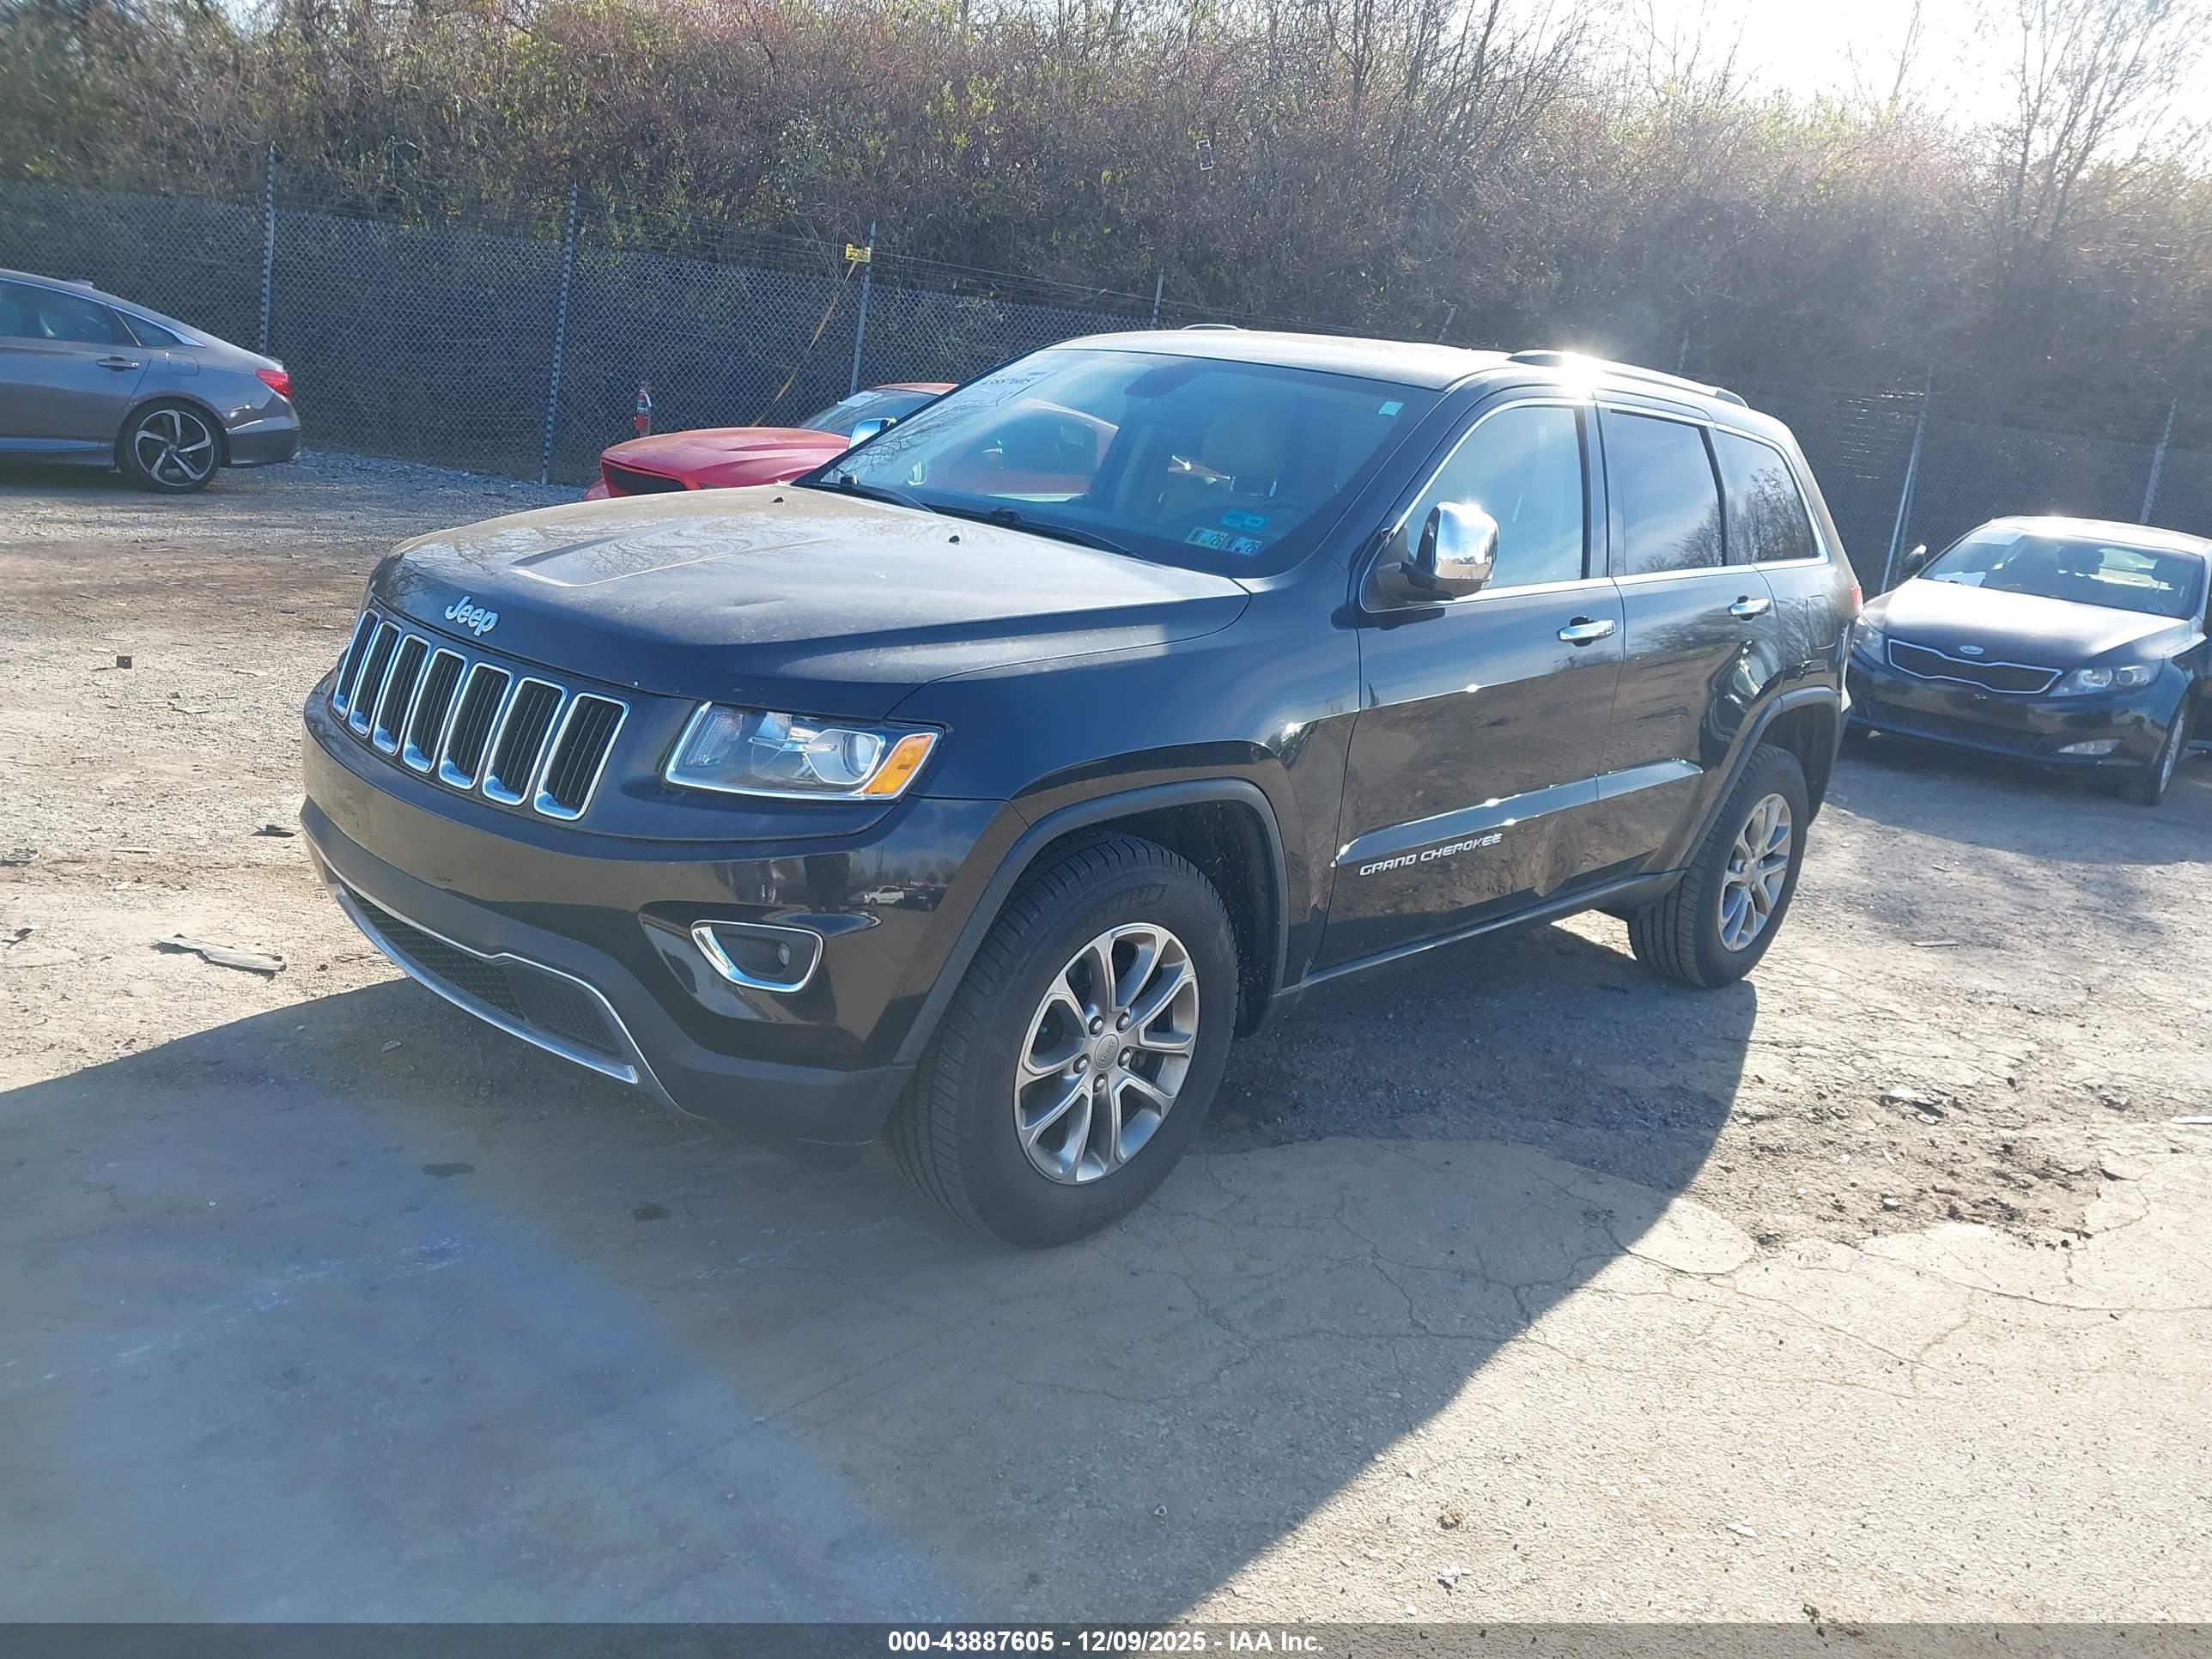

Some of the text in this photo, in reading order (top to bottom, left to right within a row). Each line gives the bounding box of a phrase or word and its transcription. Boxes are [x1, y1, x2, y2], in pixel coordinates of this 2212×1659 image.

[445, 595, 499, 636] Jeep
[1359, 832, 1504, 876] GRAND CHEROKEE
